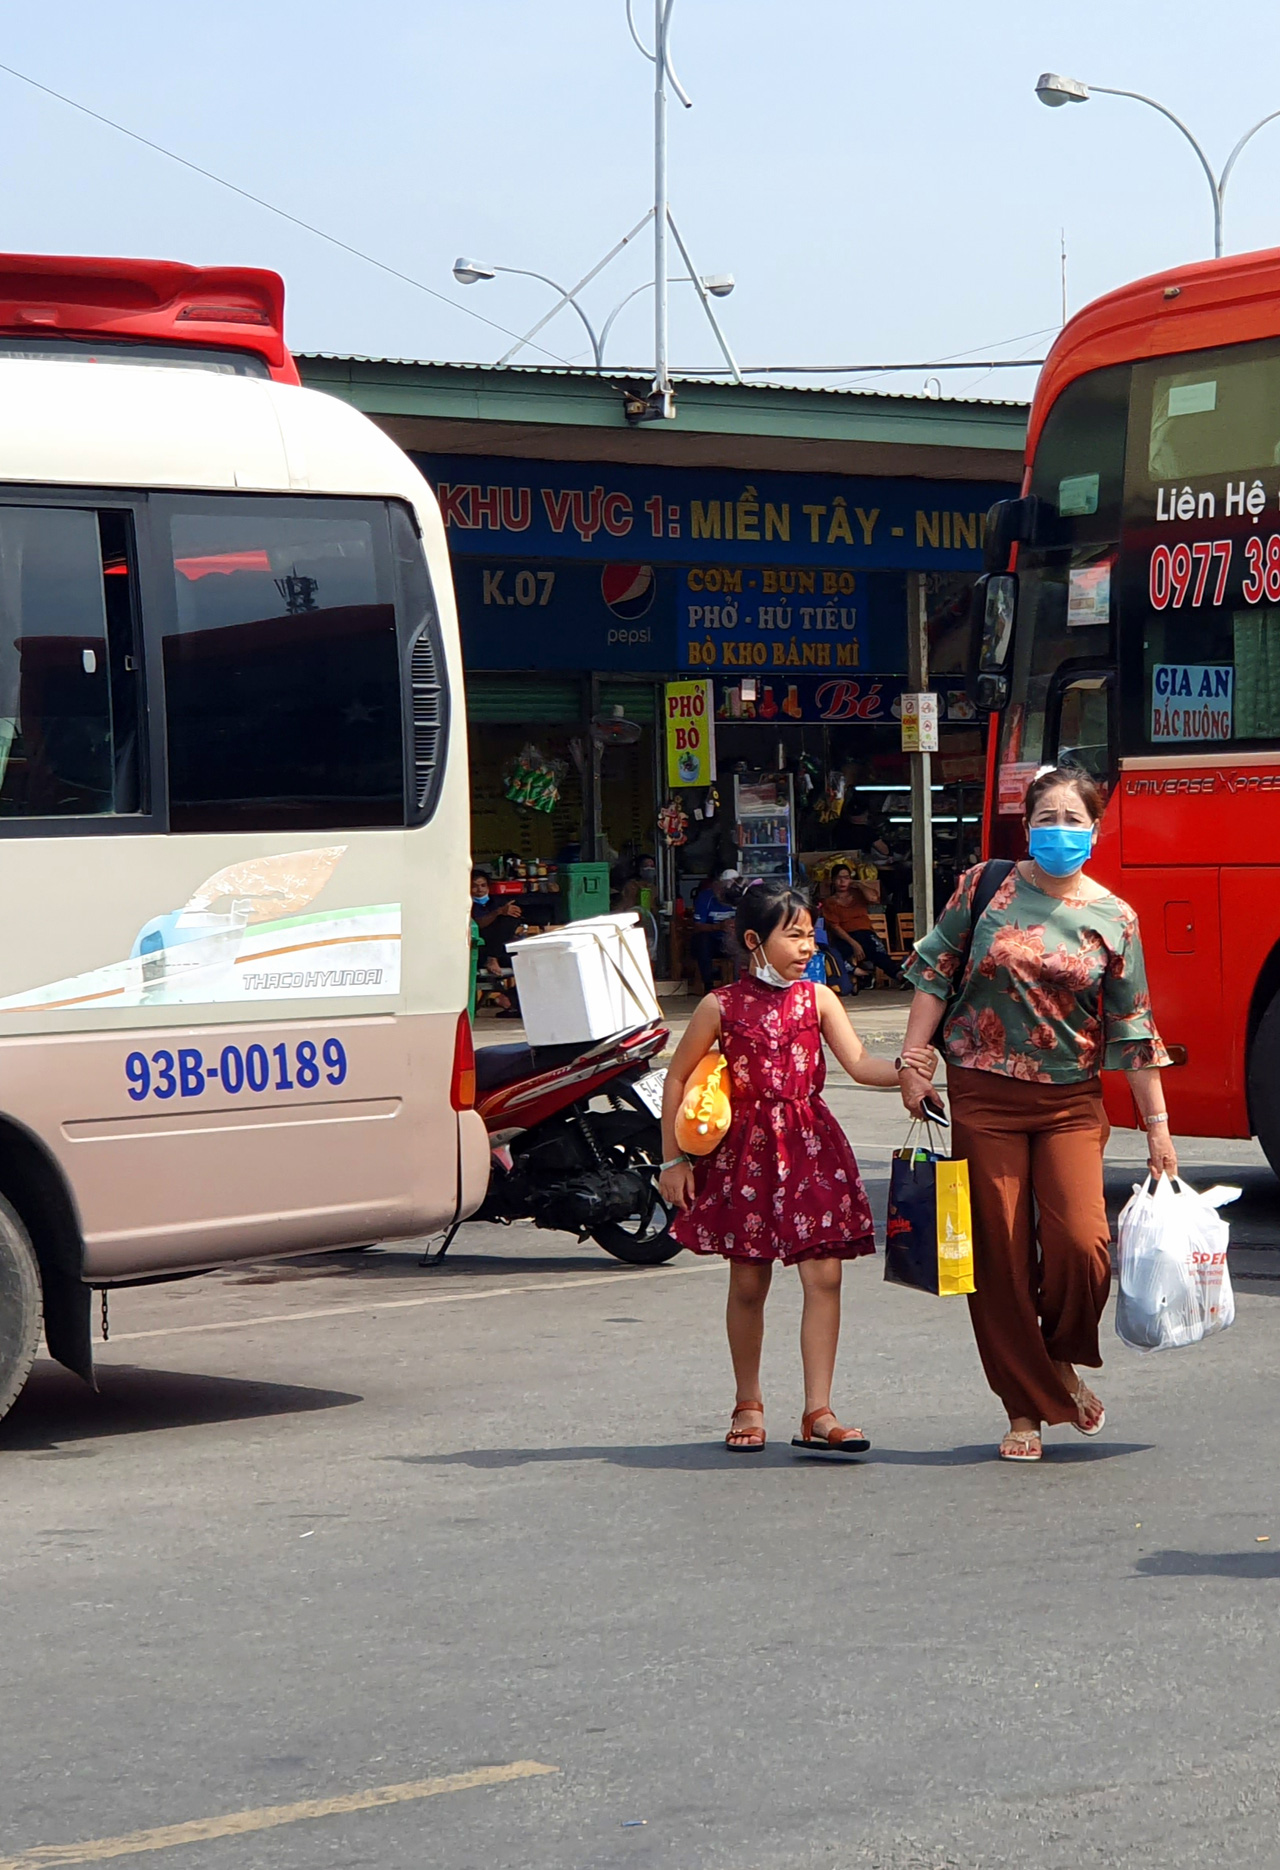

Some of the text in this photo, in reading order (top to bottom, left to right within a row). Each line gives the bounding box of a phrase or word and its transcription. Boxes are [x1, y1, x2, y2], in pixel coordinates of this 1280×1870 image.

[438, 483, 531, 532] KHU
[541, 485, 634, 542] VỰC
[644, 495, 681, 538] 1:
[690, 485, 790, 541] MIỀN
[802, 496, 880, 545] TÂY
[1156, 486, 1215, 521] Liên
[1225, 480, 1266, 523] Hệ
[482, 569, 555, 606] K.07
[1150, 539, 1232, 611] 0977
[687, 596, 739, 629] PHỞ
[758, 597, 793, 630] HỦ
[800, 597, 857, 630] TIẾU
[607, 626, 652, 646] pepsi
[688, 635, 859, 667] BÒ KHO BÁNH MÌ
[1155, 667, 1230, 697] GIA AN
[668, 685, 705, 719] PHỞ
[815, 679, 884, 720] Bé
[675, 722, 700, 750] BÒ
[1125, 777, 1215, 795] UNIVERSE
[125, 1037, 348, 1101] 93B-00189
